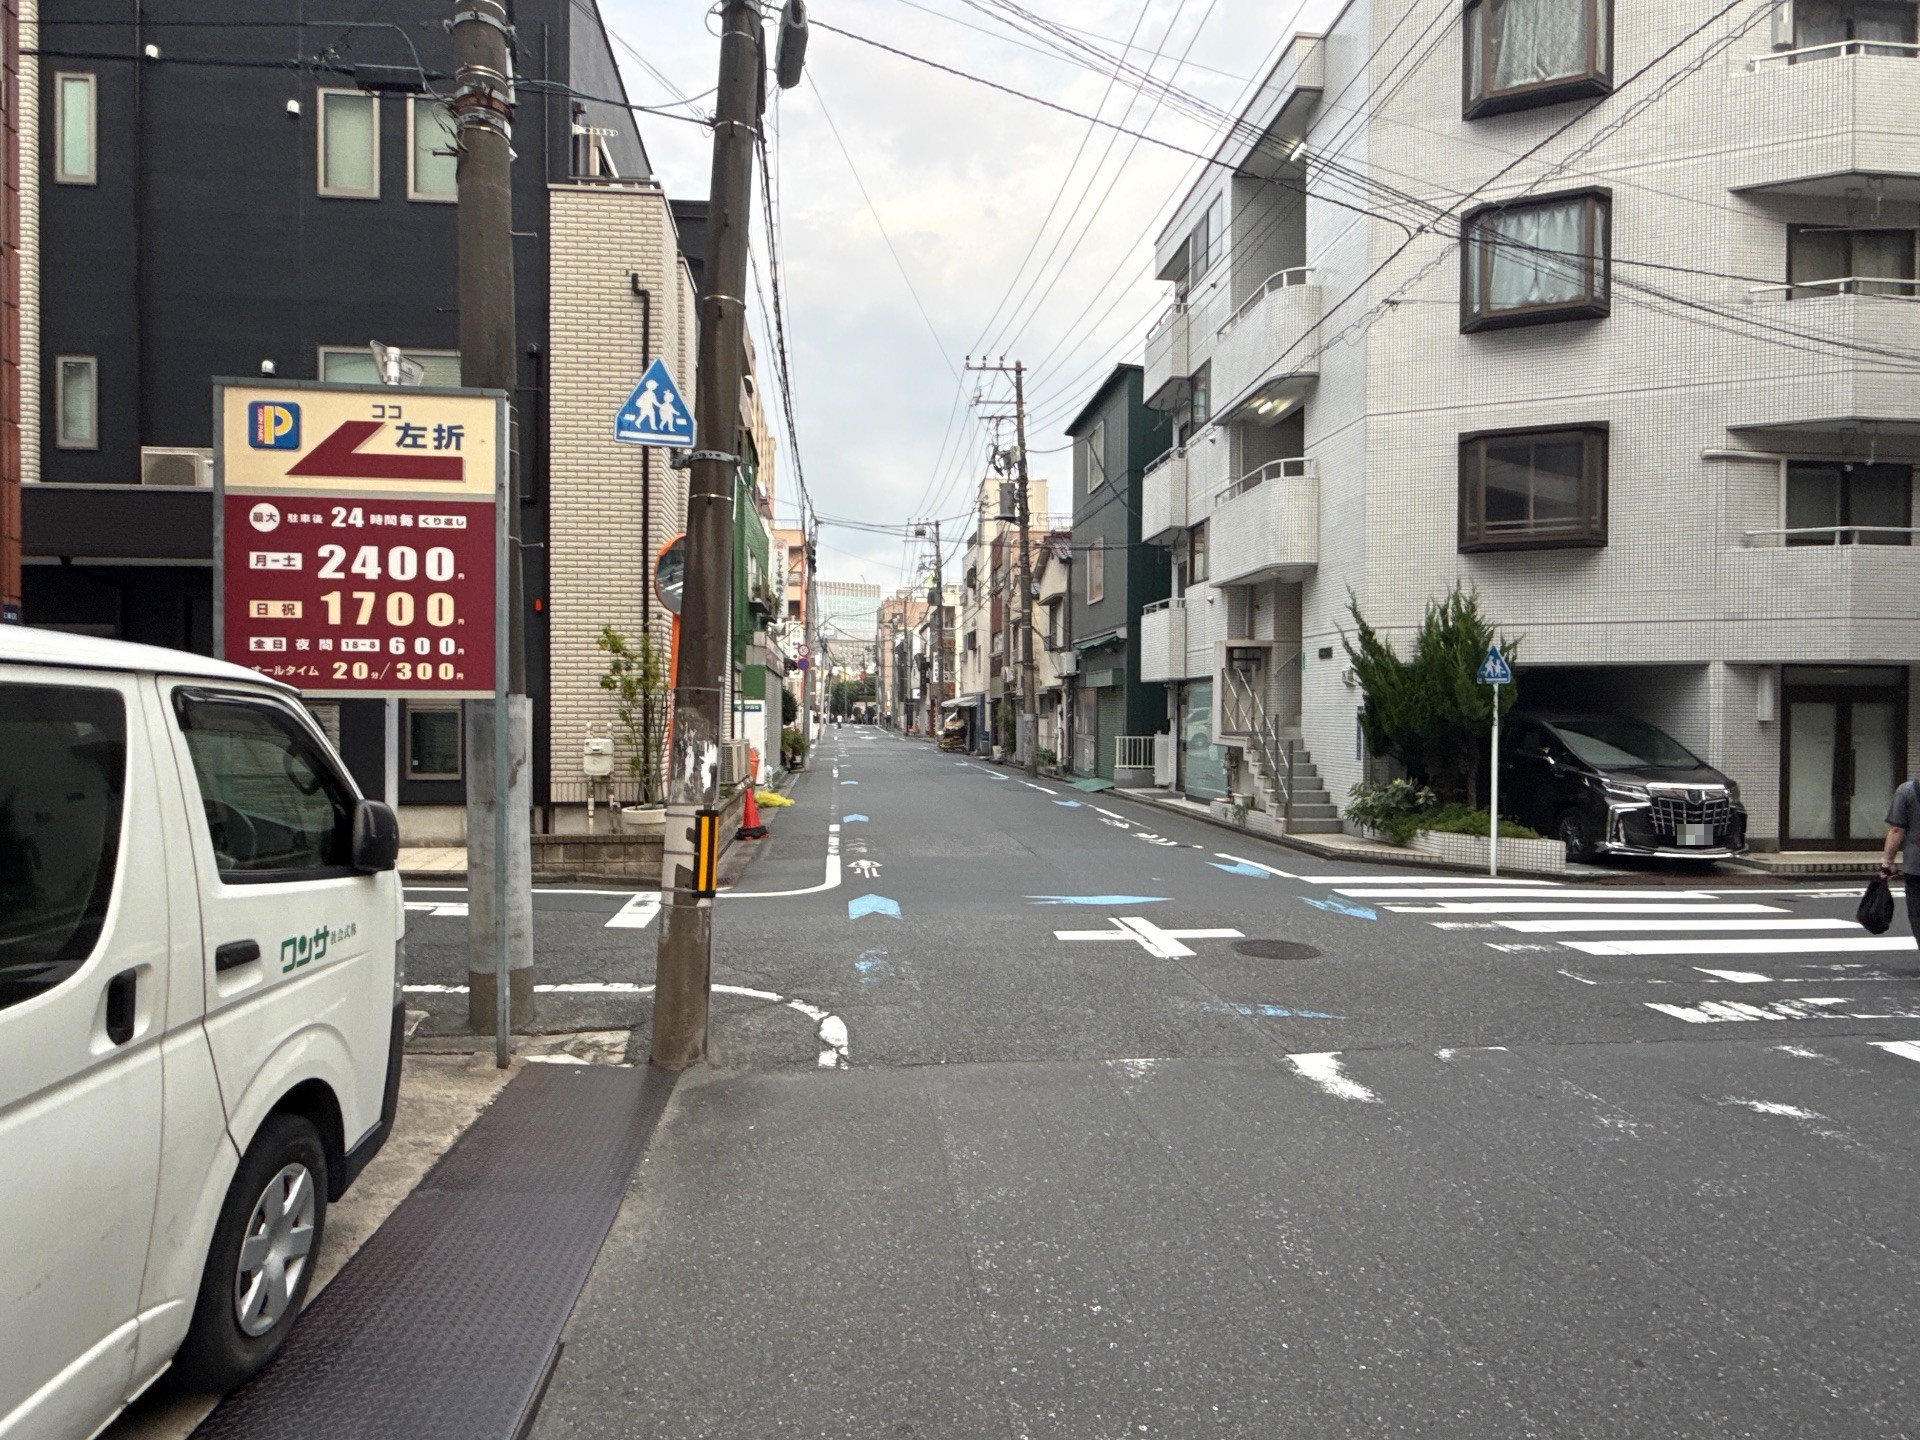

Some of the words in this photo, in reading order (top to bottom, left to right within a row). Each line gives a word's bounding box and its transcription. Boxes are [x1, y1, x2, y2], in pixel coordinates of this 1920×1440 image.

[372, 404, 402, 419] ココ
[395, 422, 465, 451] 左折
[253, 512, 278, 523] 最大
[422, 517, 465, 527] くり返し
[256, 603, 296, 617] 日祝
[253, 638, 284, 650] 全日
[295, 638, 333, 651] 夜間
